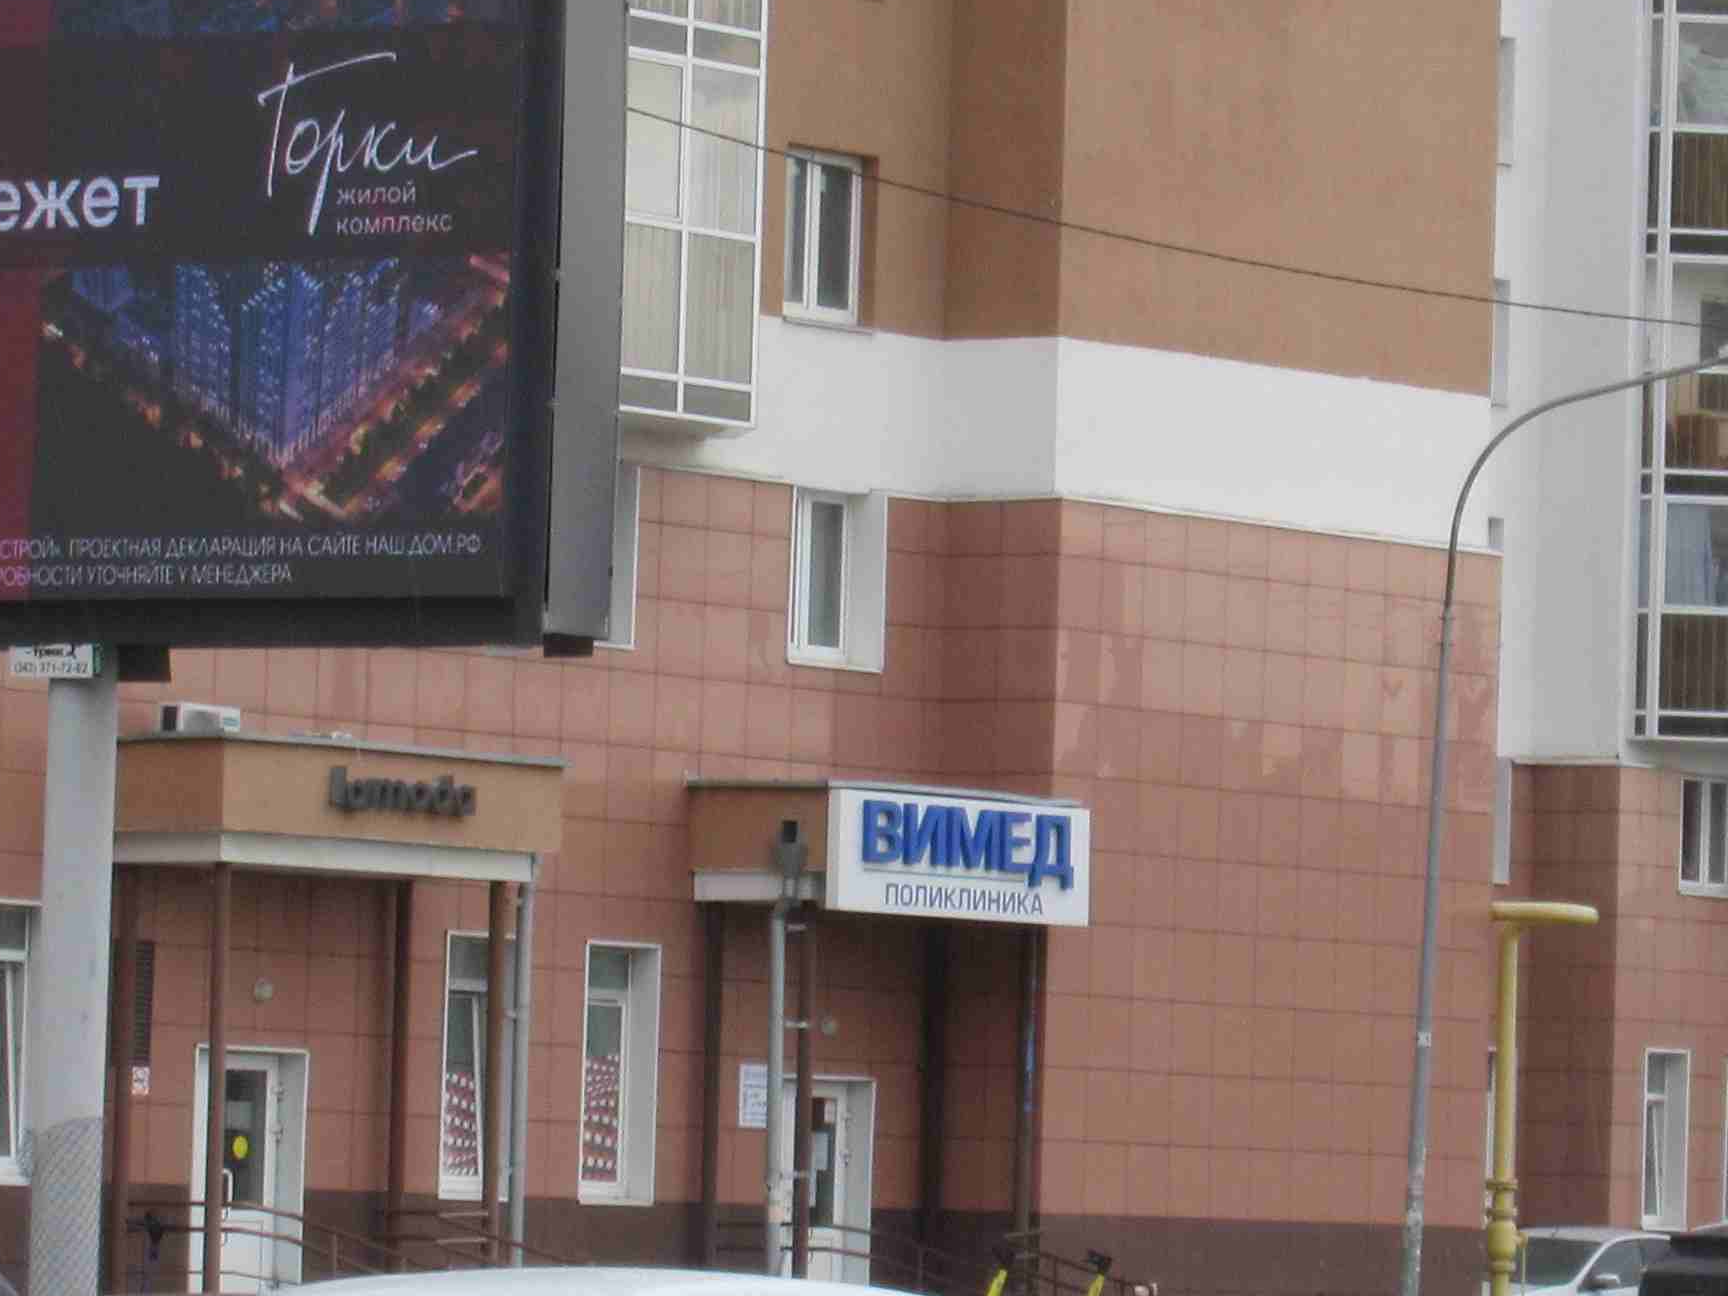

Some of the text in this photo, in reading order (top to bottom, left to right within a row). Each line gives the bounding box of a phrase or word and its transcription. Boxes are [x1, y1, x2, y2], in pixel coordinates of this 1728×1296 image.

[257, 52, 478, 235] Горки
[337, 179, 415, 205] жилой
[337, 213, 452, 235] комплекс
[69, 536, 161, 559] ПРОЕКТНАЯ
[165, 535, 275, 560] ДЕКЛАРАЦИЯ
[280, 536, 302, 555] НА
[308, 531, 360, 555] САЙТЕ
[87, 561, 175, 585] УТОЧНЯЙТЕ
[191, 561, 292, 585] МЕНЕДЖЕРА
[328, 766, 477, 817] lamoda
[861, 799, 1075, 891] ВИМЕД
[885, 882, 1043, 915] ПОЛИКЛИНИКА
